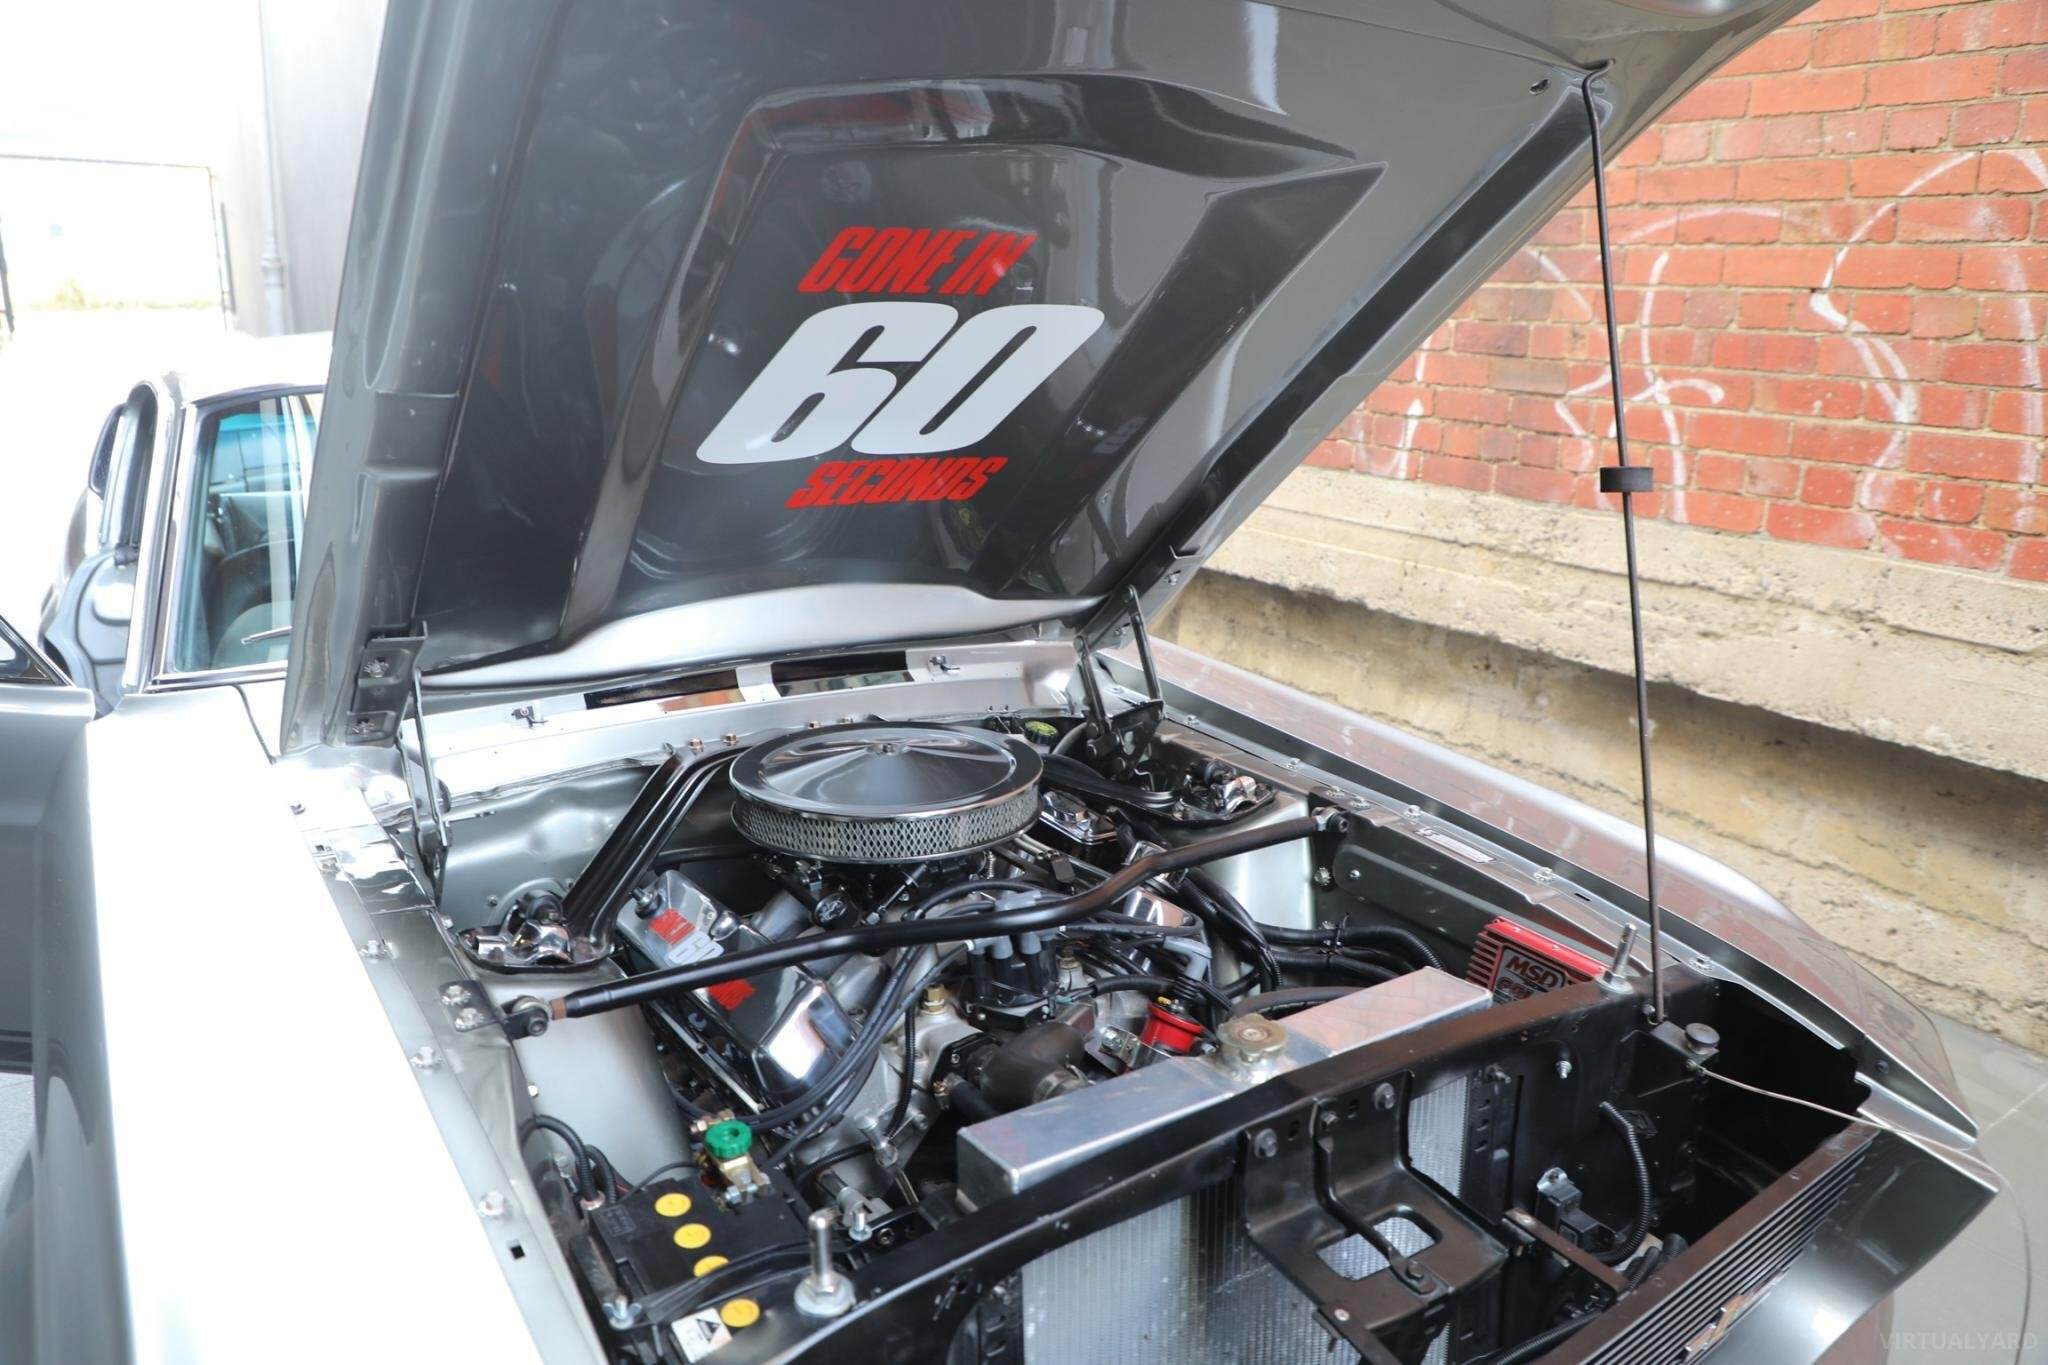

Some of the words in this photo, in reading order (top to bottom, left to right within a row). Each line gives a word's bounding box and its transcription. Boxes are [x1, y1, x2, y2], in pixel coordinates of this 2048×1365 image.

[797, 226, 979, 293] GONE
[938, 230, 1037, 296] IN
[696, 301, 1105, 465] 60
[785, 455, 1008, 509] SECONDS
[1505, 955, 1559, 988] MSD
